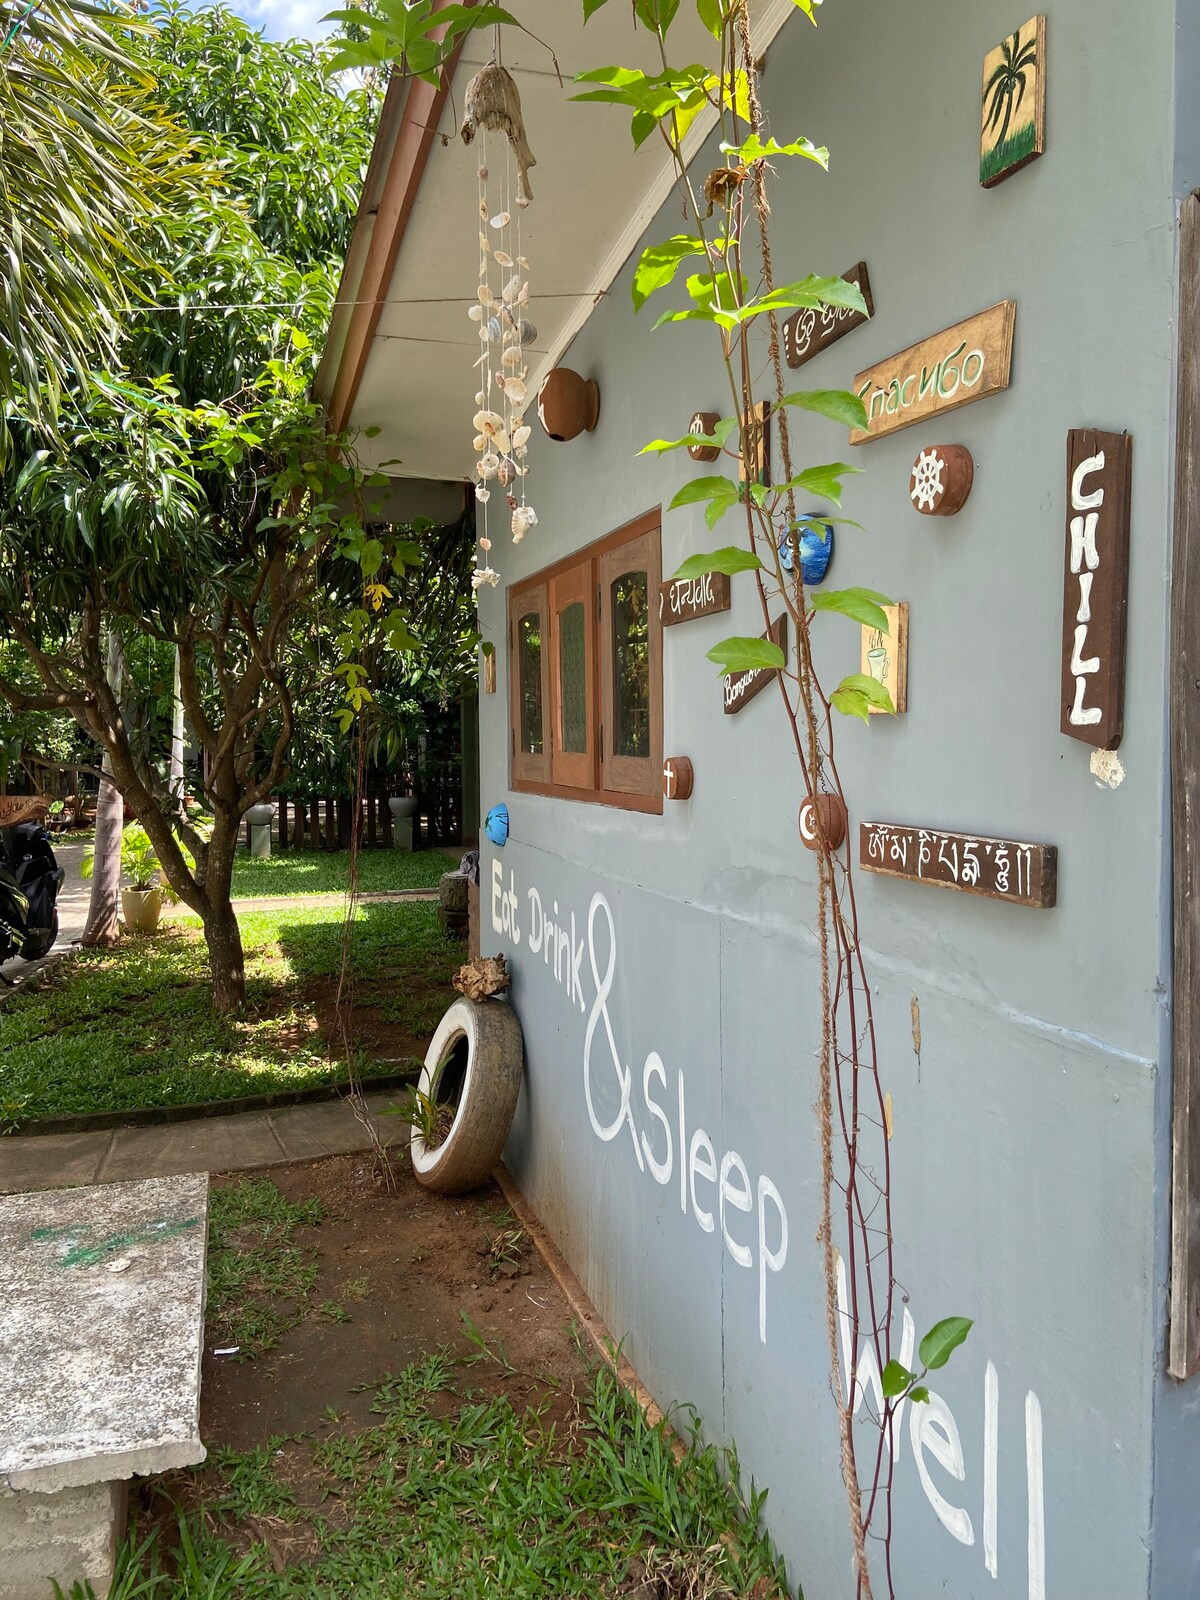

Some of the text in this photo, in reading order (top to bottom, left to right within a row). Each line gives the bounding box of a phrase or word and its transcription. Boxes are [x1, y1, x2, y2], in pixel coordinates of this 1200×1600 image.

[1069, 450, 1105, 725] CHILL
[491, 857, 1046, 1600] Eat Drink & Sleep Well
